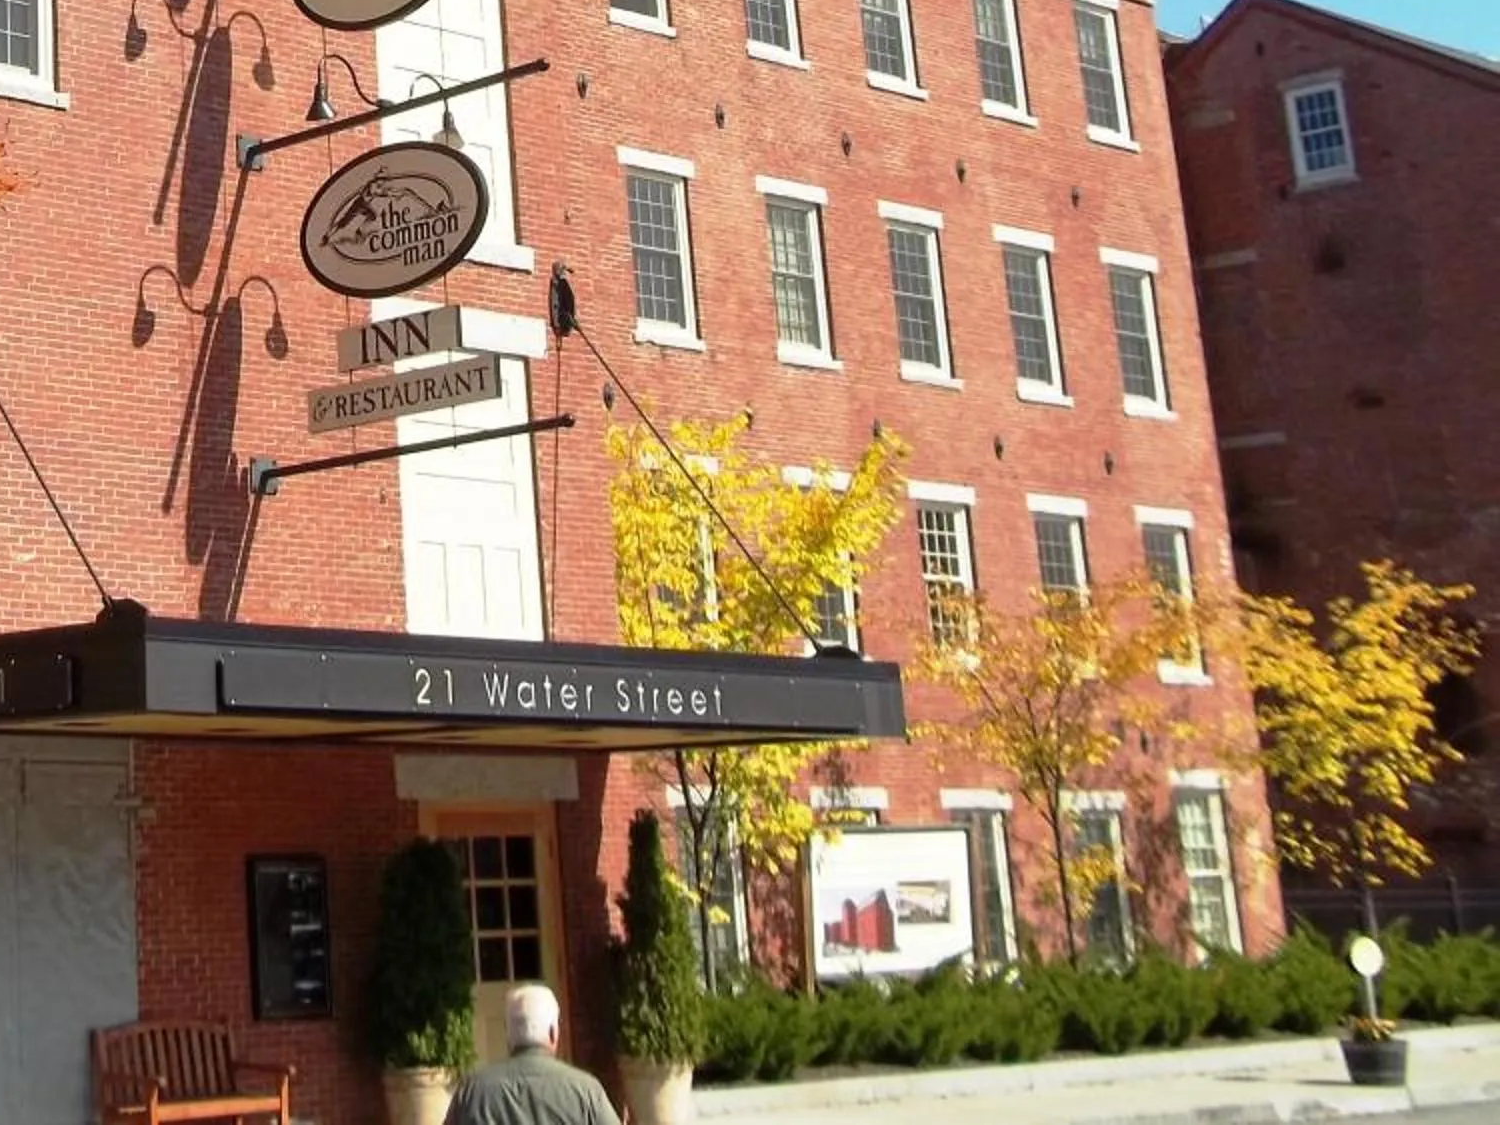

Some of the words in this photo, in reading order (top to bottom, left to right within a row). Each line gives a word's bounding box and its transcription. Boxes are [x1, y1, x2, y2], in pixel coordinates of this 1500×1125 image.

[369, 212, 459, 253] common
[380, 201, 410, 229] the
[403, 238, 445, 266] man
[360, 311, 433, 364] INN
[334, 366, 490, 419] RESTAURANT
[415, 668, 453, 706] 21
[483, 671, 593, 712] Water
[617, 678, 724, 716] Street
